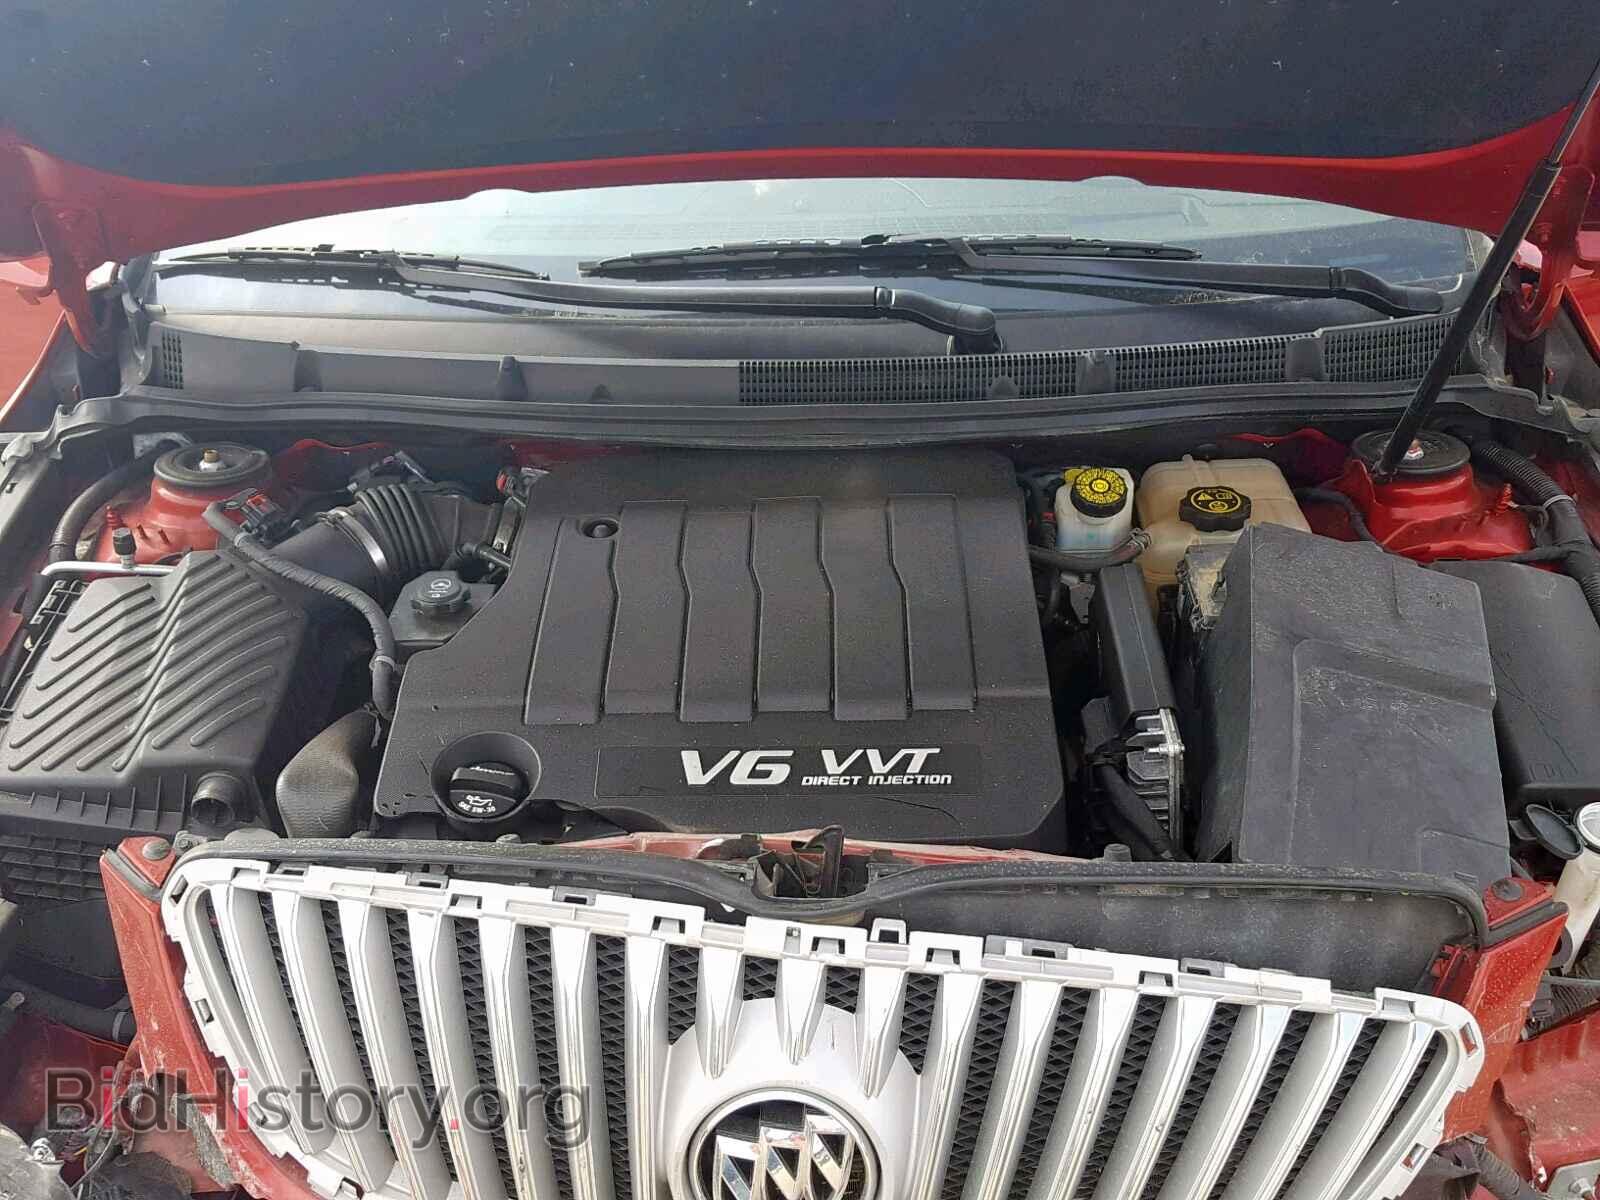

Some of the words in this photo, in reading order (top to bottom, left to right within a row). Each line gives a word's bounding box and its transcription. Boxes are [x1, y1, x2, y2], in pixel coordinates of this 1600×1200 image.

[680, 750, 794, 785] V6
[821, 748, 941, 774] VVT
[801, 775, 862, 786] DIRECT
[868, 774, 952, 785] INJECTION
